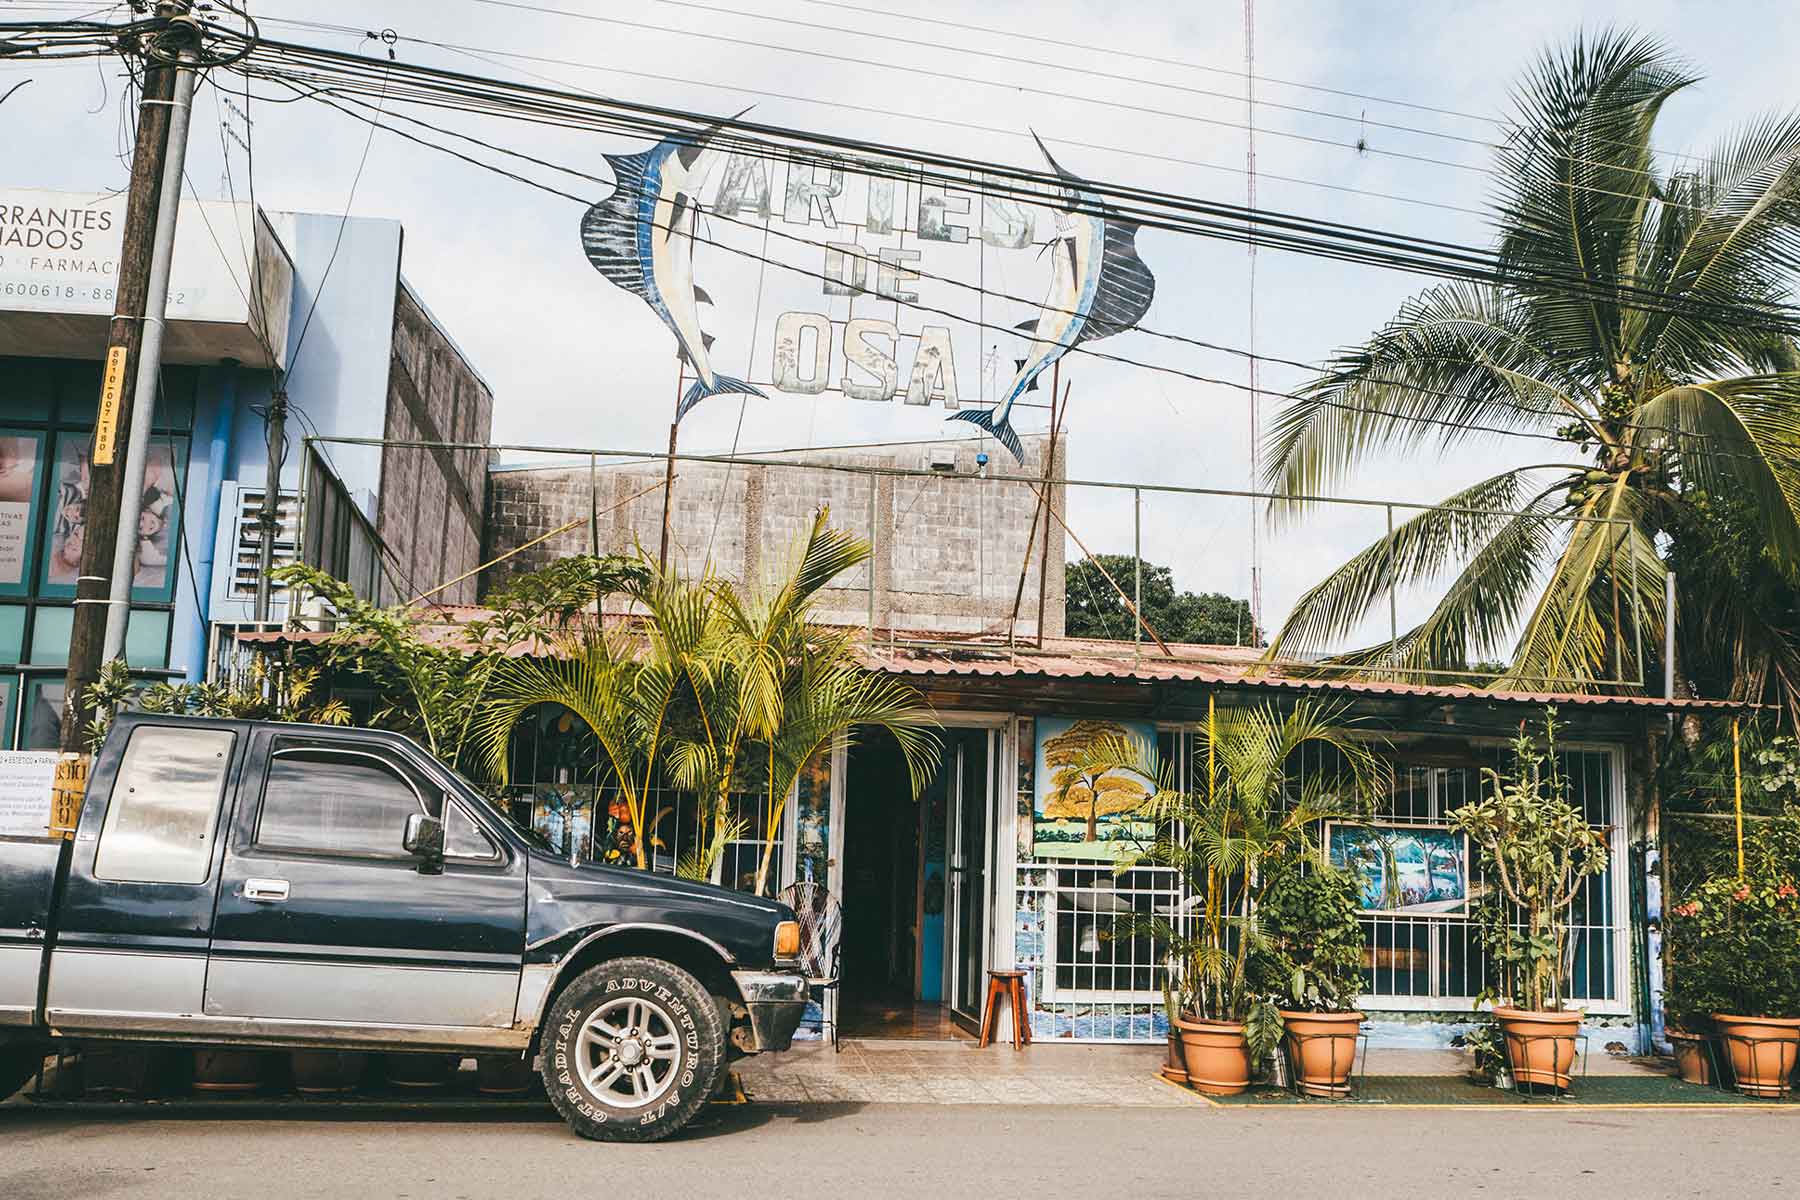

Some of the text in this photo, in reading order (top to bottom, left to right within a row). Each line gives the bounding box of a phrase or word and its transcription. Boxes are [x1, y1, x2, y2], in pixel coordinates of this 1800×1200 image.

[712, 138, 1035, 249] ARTES
[0, 282, 74, 298] 600618
[822, 240, 922, 303] DE
[772, 311, 961, 410] OSA
[605, 977, 698, 1087] ADVENTURO
